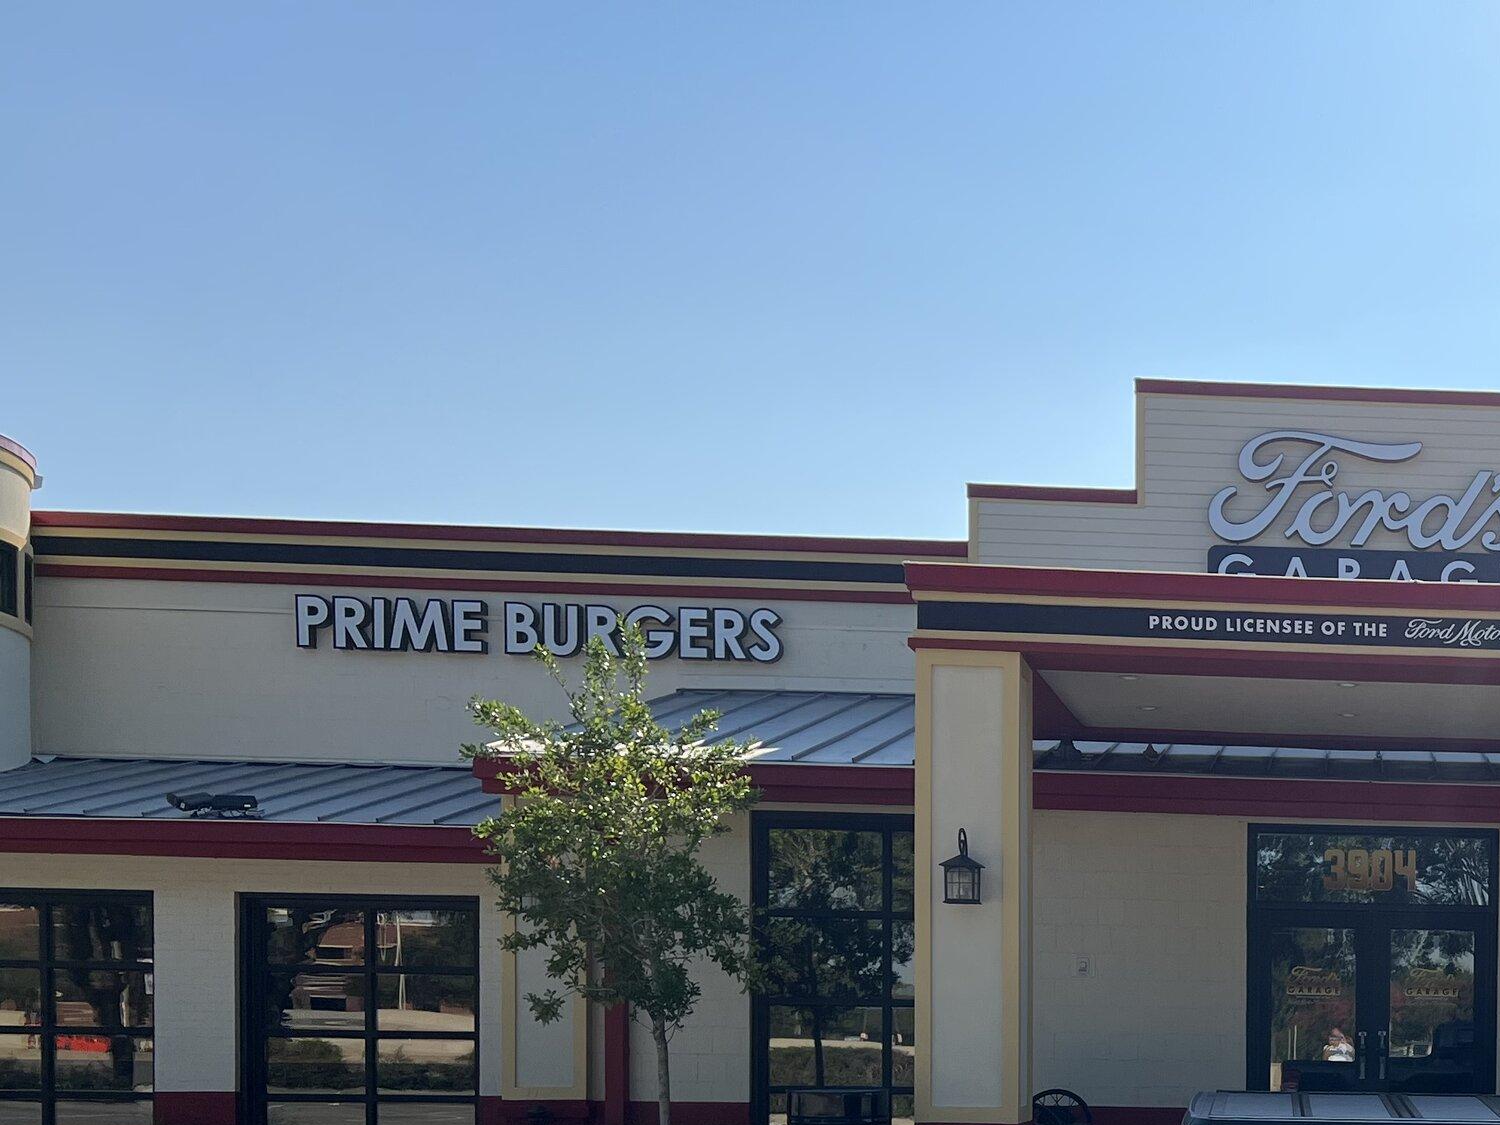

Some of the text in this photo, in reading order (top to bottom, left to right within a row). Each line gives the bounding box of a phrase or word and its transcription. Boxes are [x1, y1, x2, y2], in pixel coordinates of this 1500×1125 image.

[295, 594, 784, 663] PRIME BURGERS
[1149, 615, 1217, 631] PROUD
[1226, 618, 1313, 635] LICENSEE
[1321, 621, 1346, 636] OF
[1353, 622, 1387, 637] THE
[1404, 618, 1455, 643] Ford
[1323, 849, 1417, 892] 3904
